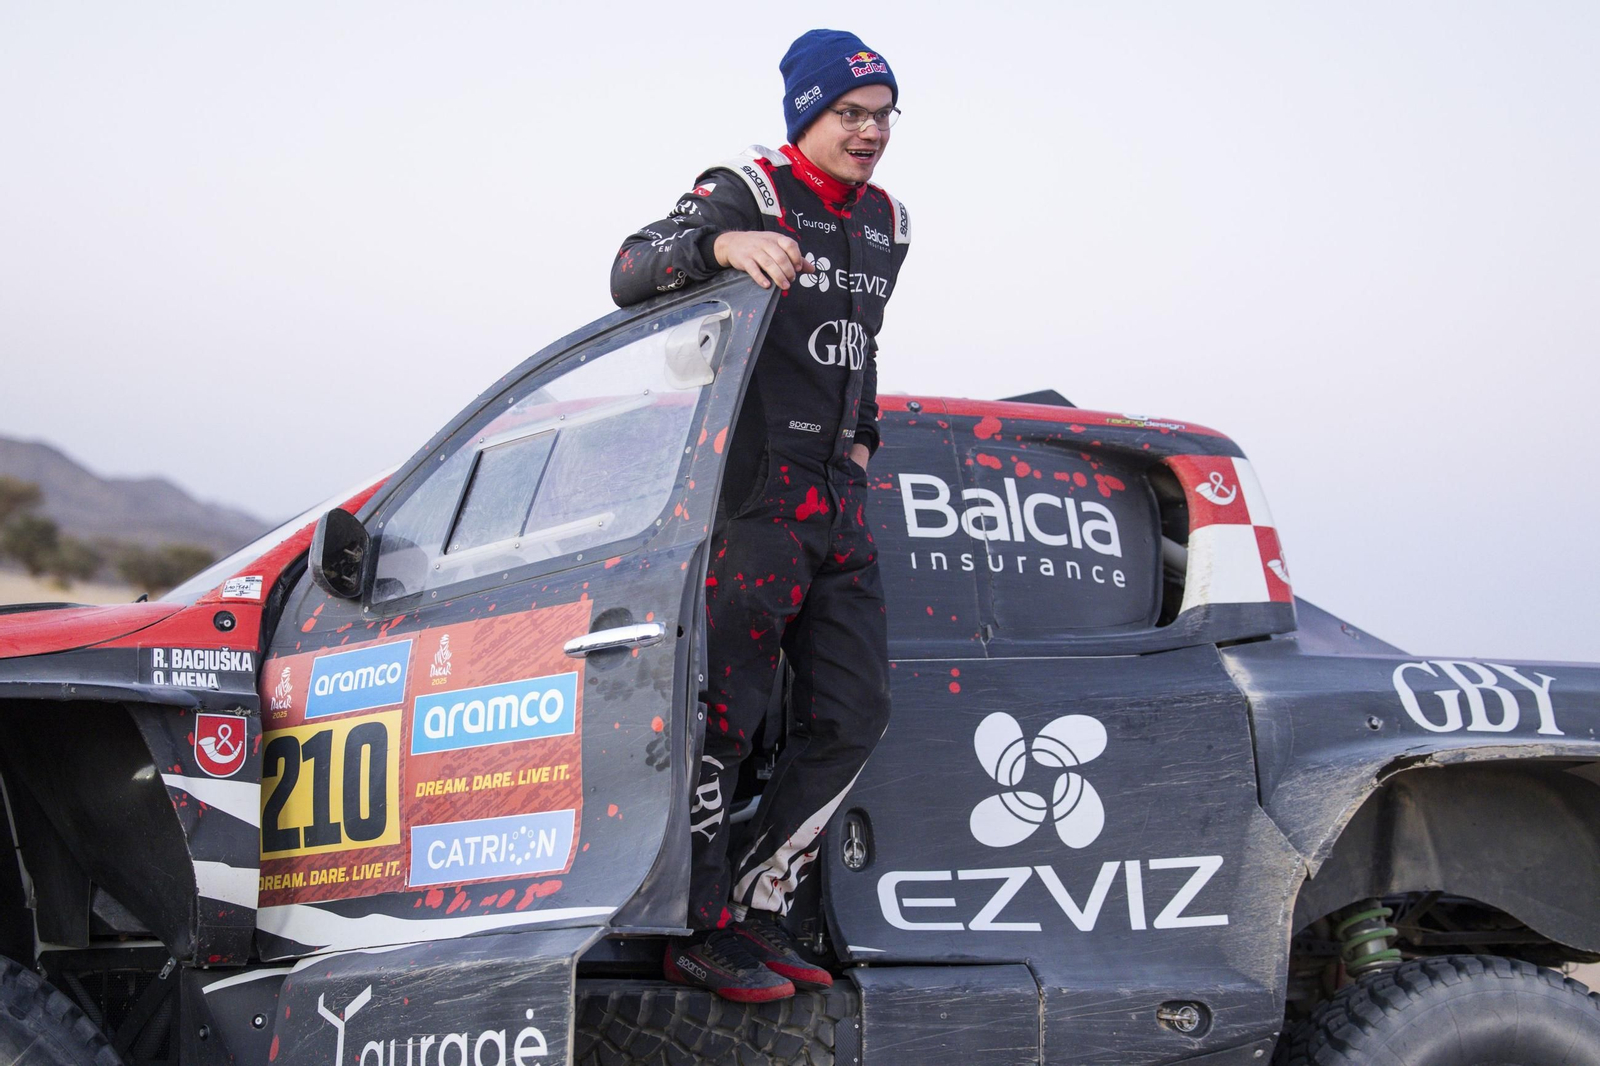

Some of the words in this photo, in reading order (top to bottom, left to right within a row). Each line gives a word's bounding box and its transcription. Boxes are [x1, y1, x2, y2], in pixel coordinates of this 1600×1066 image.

[852, 63, 873, 77] Red
[873, 63, 887, 73] Bull
[795, 85, 821, 109] Balcia
[740, 165, 774, 208] sparco
[864, 225, 890, 247] Balcia
[835, 269, 888, 298] EZVIZ
[808, 319, 867, 370] GBY
[788, 420, 821, 433] sparco
[898, 473, 1122, 558] Balcia
[910, 551, 1127, 588] insurance
[153, 648, 168, 668] R.
[172, 647, 253, 672] BACIUŠKA
[430, 662, 452, 678] DAKAR
[172, 672, 219, 689] MENA
[314, 662, 401, 696] aramco
[432, 677, 447, 685] 2025
[1392, 660, 1565, 736] GBY
[272, 710, 288, 719] 2025
[424, 688, 563, 739] aramco
[262, 721, 388, 854] 210
[415, 772, 470, 797] DREAM.
[472, 769, 514, 790] DARE.
[518, 765, 550, 785] LIVE
[553, 764, 570, 781] IT.
[310, 867, 350, 886] DARE.
[352, 862, 383, 881] LIVE
[385, 861, 401, 877] IT.
[877, 855, 1229, 932] EZVIZ
[676, 955, 707, 981] sparco
